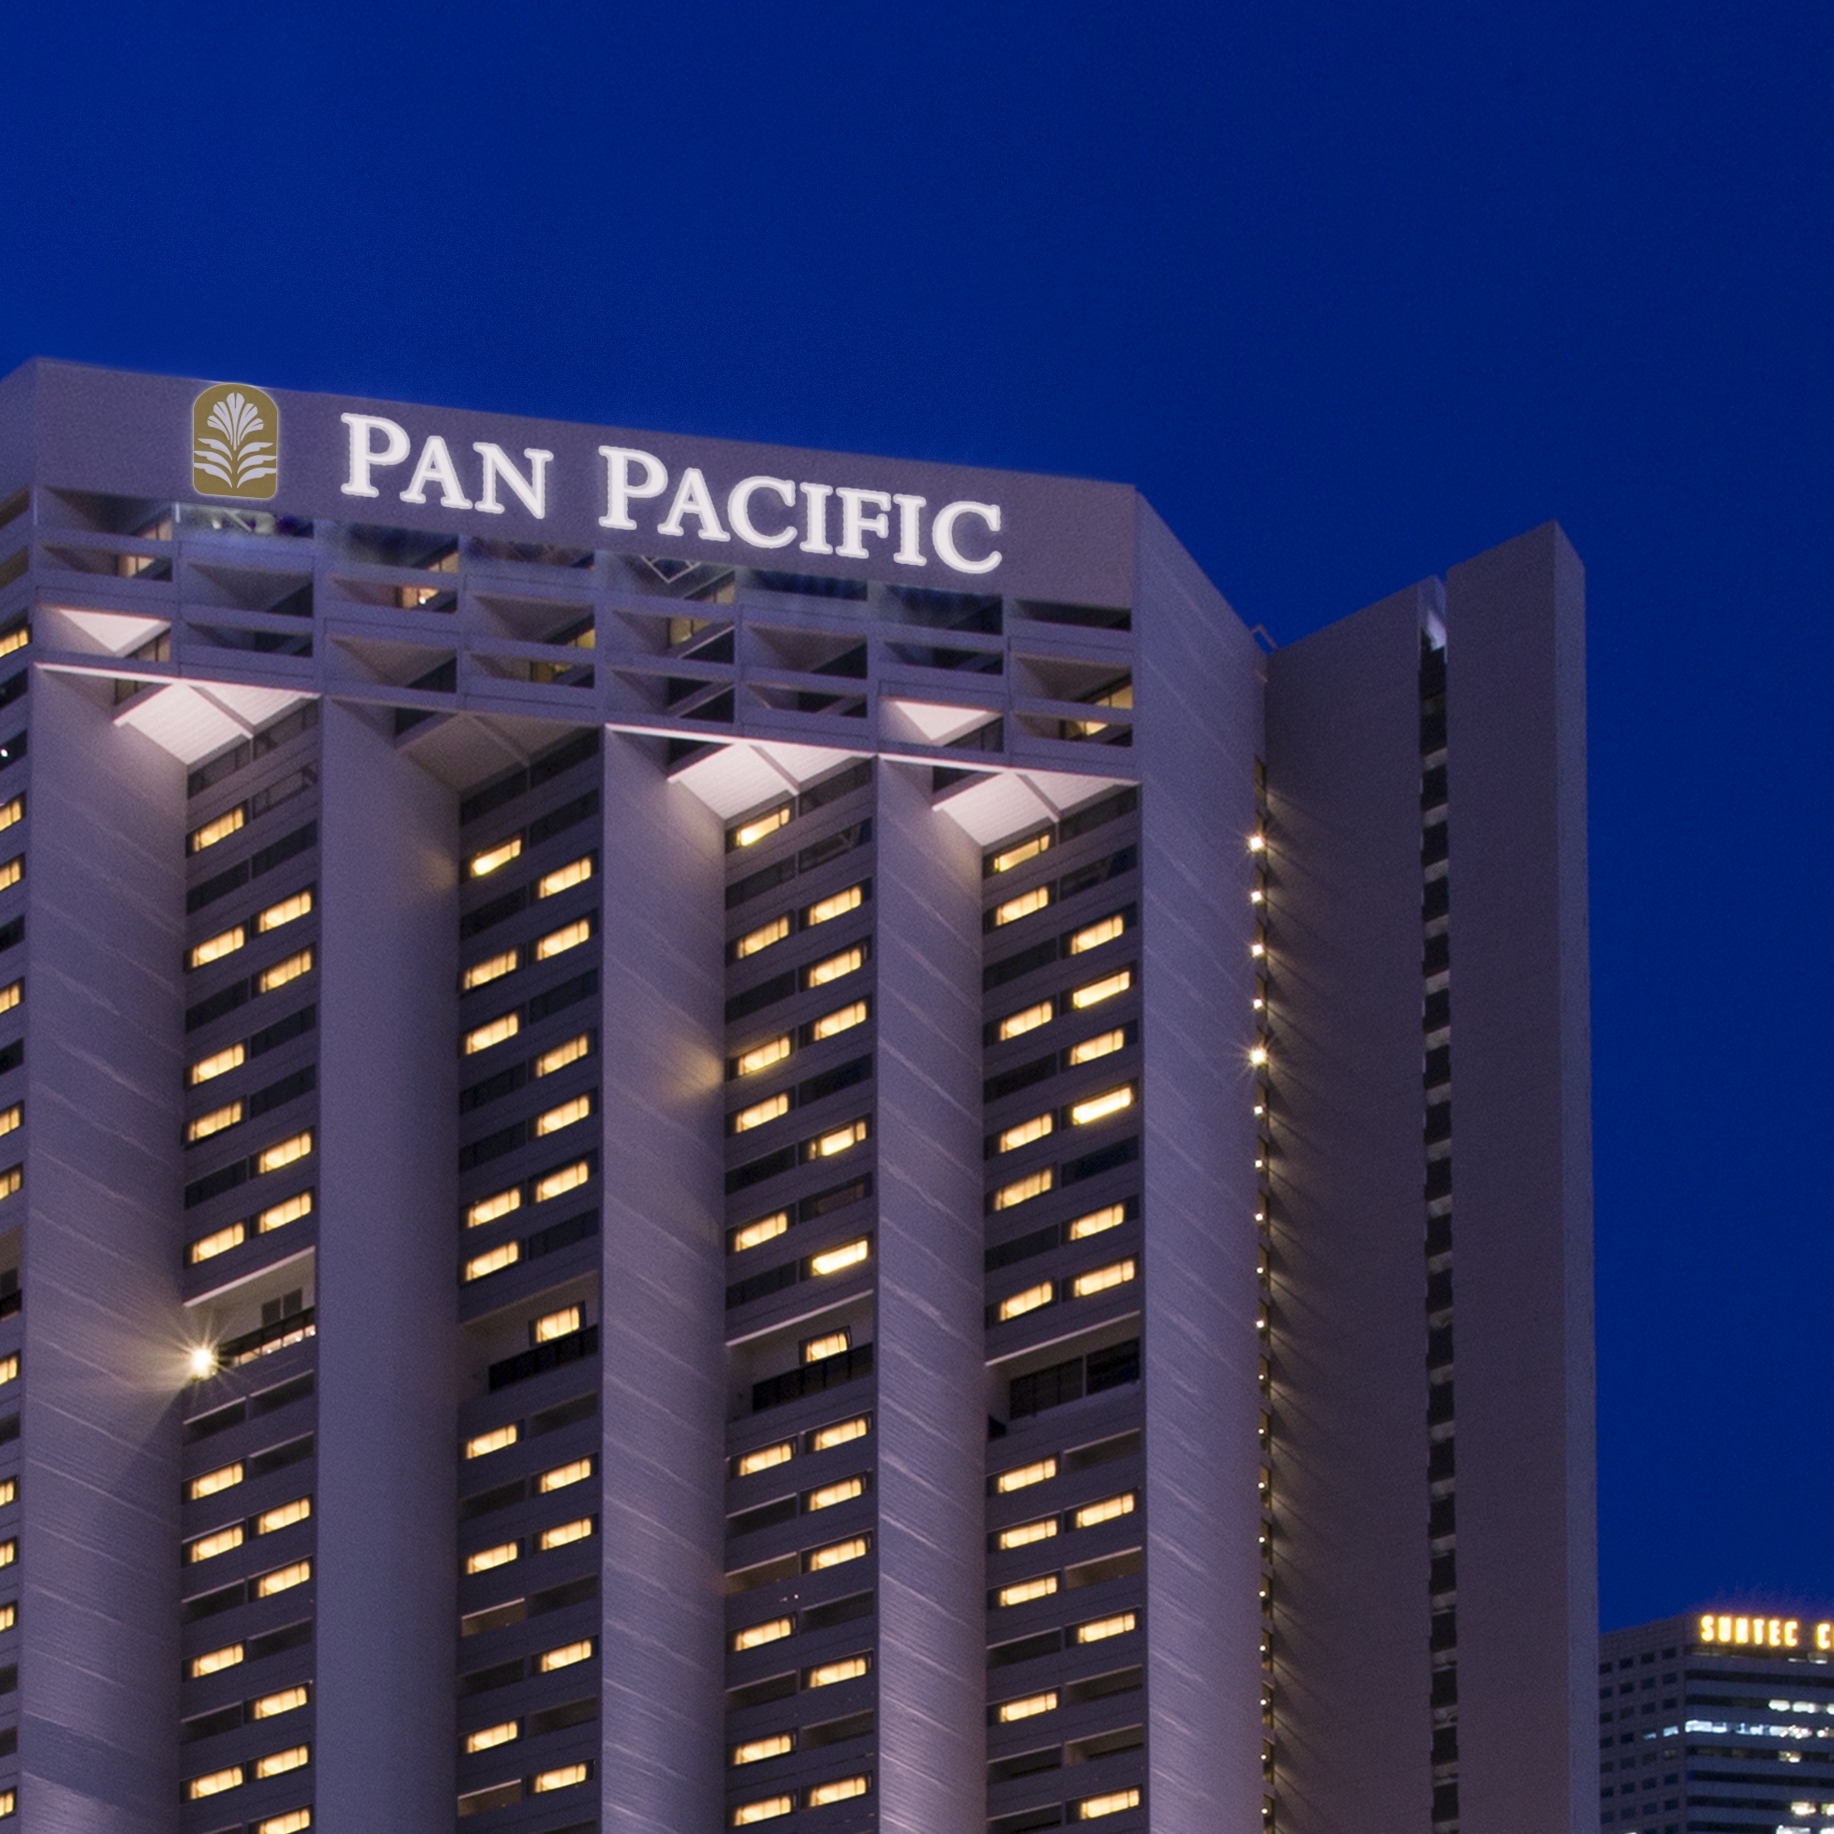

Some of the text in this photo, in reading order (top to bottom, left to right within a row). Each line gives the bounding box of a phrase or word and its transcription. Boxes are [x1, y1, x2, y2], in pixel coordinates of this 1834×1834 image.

[341, 412, 1003, 574] PAN PACIFIC
[1700, 1614, 1798, 1646] SUNTEC
